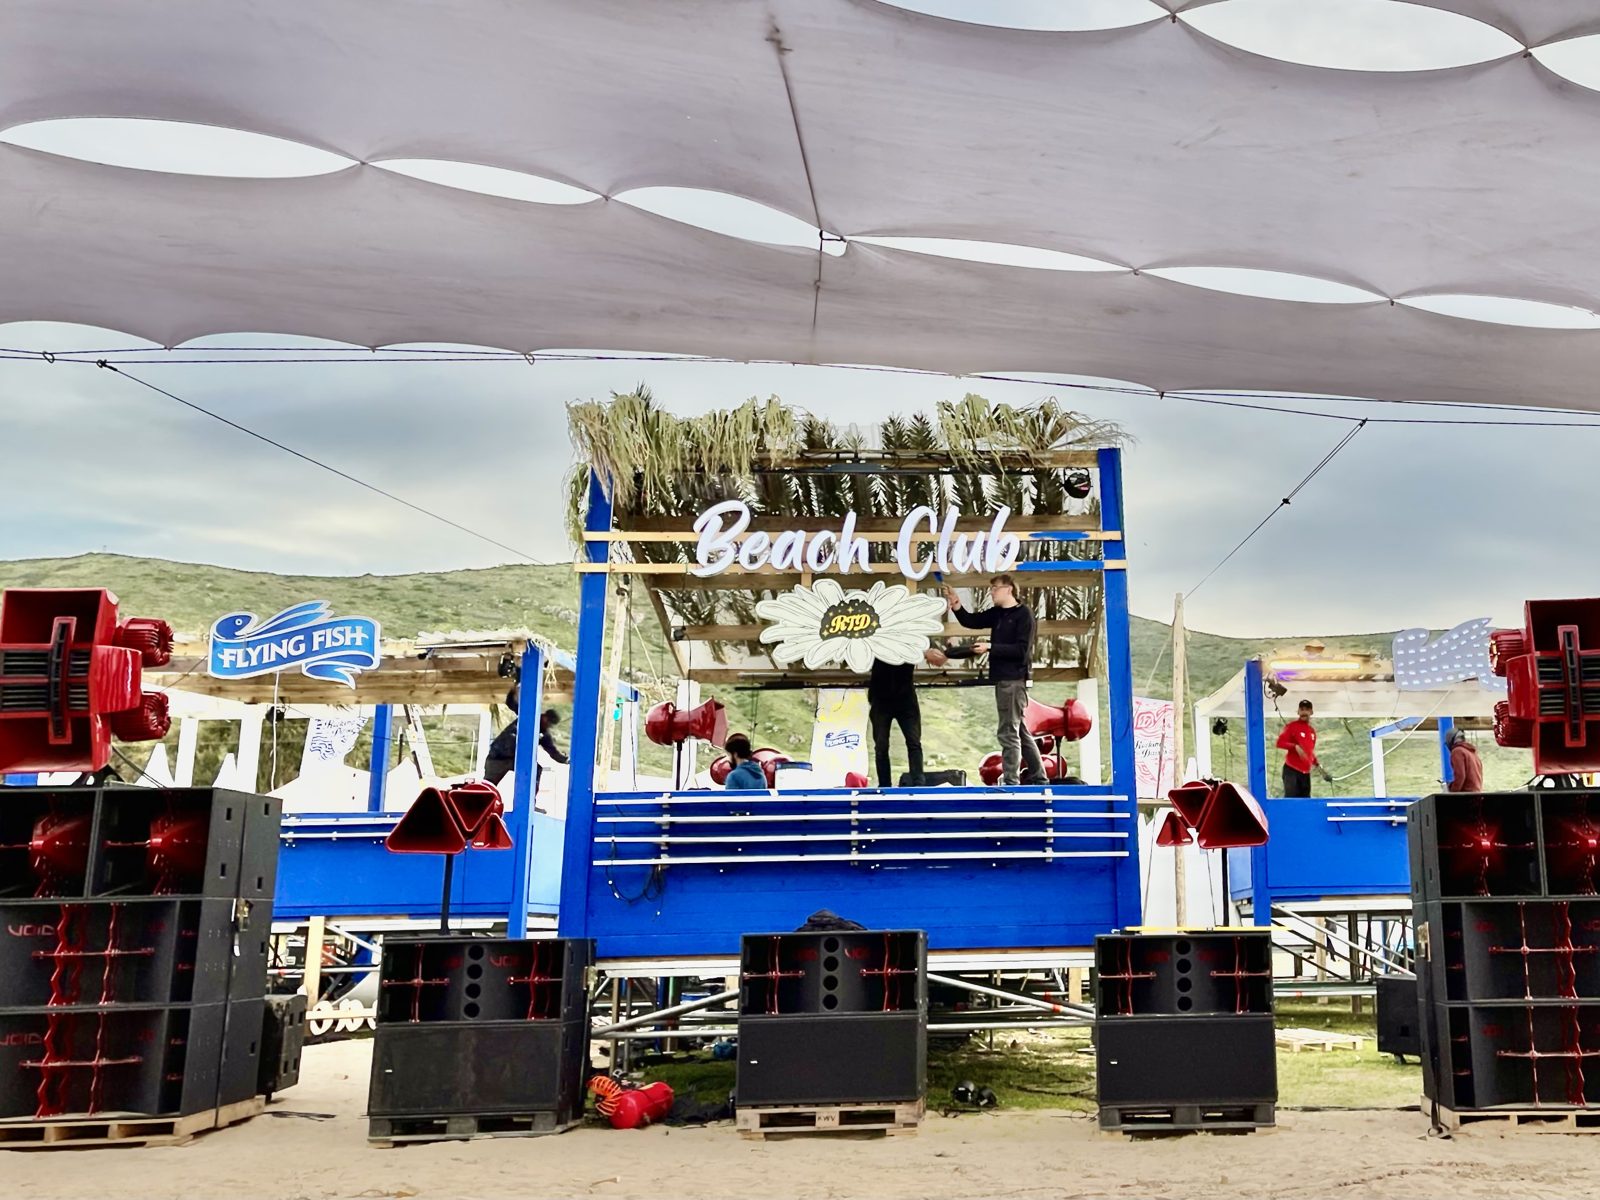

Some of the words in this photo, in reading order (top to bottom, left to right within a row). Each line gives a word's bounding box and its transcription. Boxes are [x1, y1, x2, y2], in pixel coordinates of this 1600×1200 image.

[690, 500, 873, 578] Beach
[897, 505, 1021, 582] Club
[829, 613, 871, 634] RTD
[217, 636, 305, 669] FLYING
[312, 625, 369, 652] FISH
[8, 924, 55, 937] VOID
